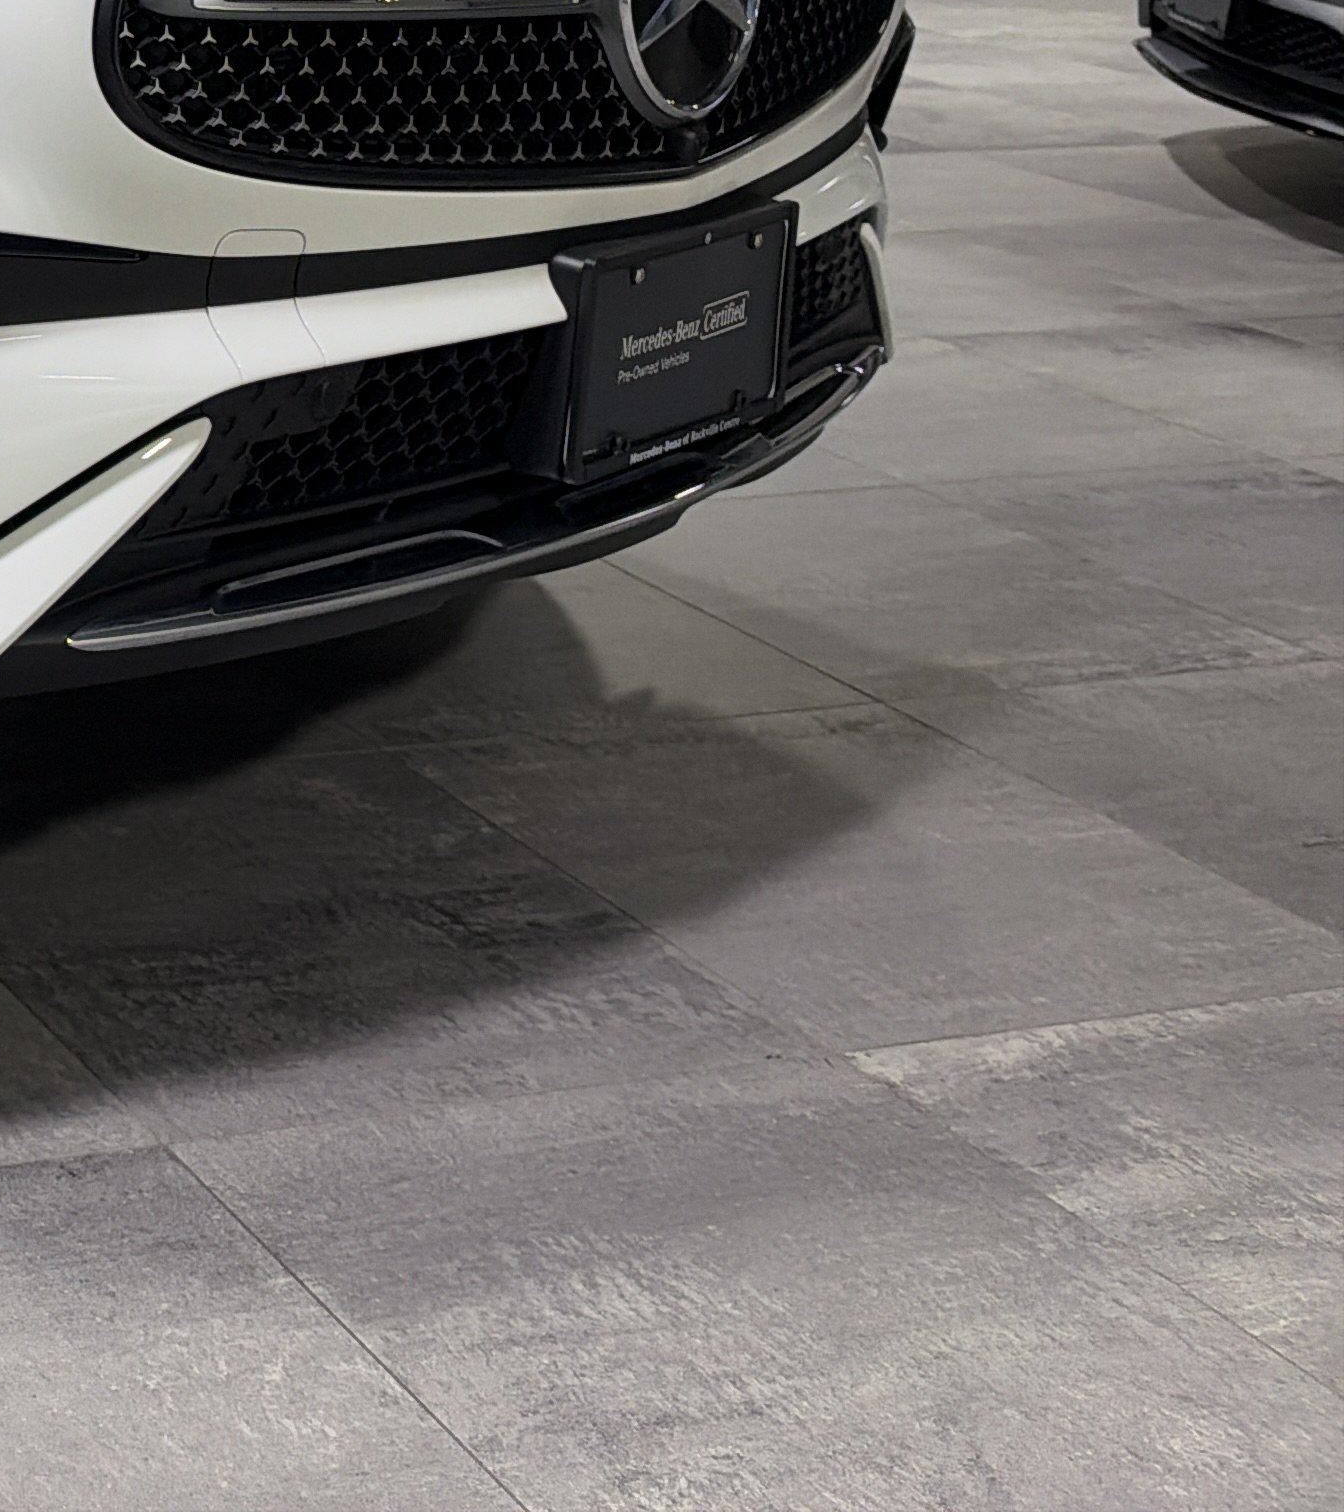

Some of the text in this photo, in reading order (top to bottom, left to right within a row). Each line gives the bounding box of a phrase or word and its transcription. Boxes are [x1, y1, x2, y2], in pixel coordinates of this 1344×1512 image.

[619, 298, 746, 360] Mercedes-Benz Certified
[617, 360, 660, 384] Pre-Owned
